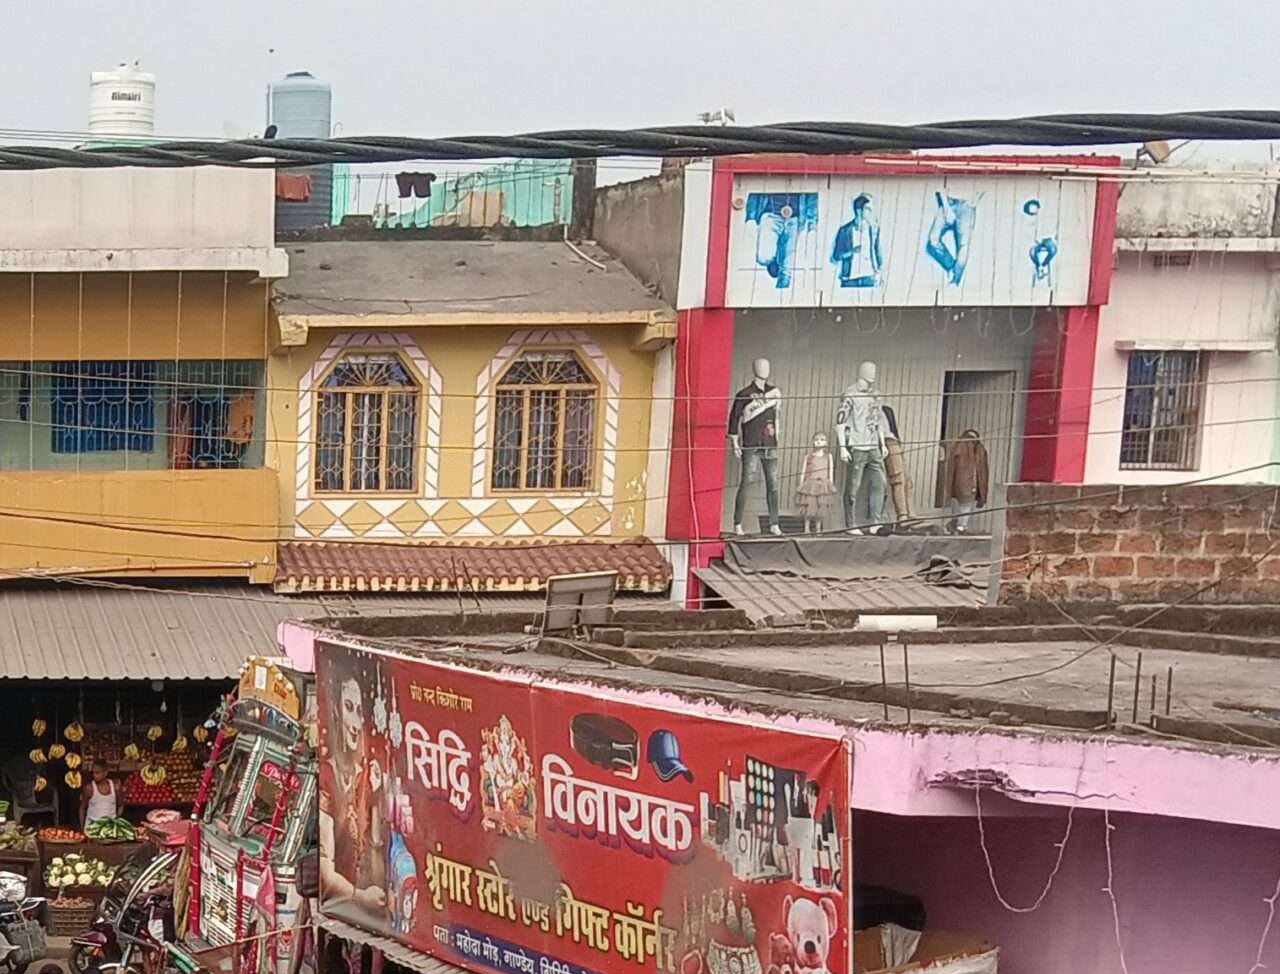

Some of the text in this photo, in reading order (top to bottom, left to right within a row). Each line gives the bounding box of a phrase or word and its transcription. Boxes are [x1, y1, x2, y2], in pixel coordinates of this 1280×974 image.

[541, 753, 695, 851] विनायक
[475, 859, 518, 921] स्टोर
[555, 882, 610, 951] गिफ्ट
[613, 903, 678, 973] कॉर्नर
